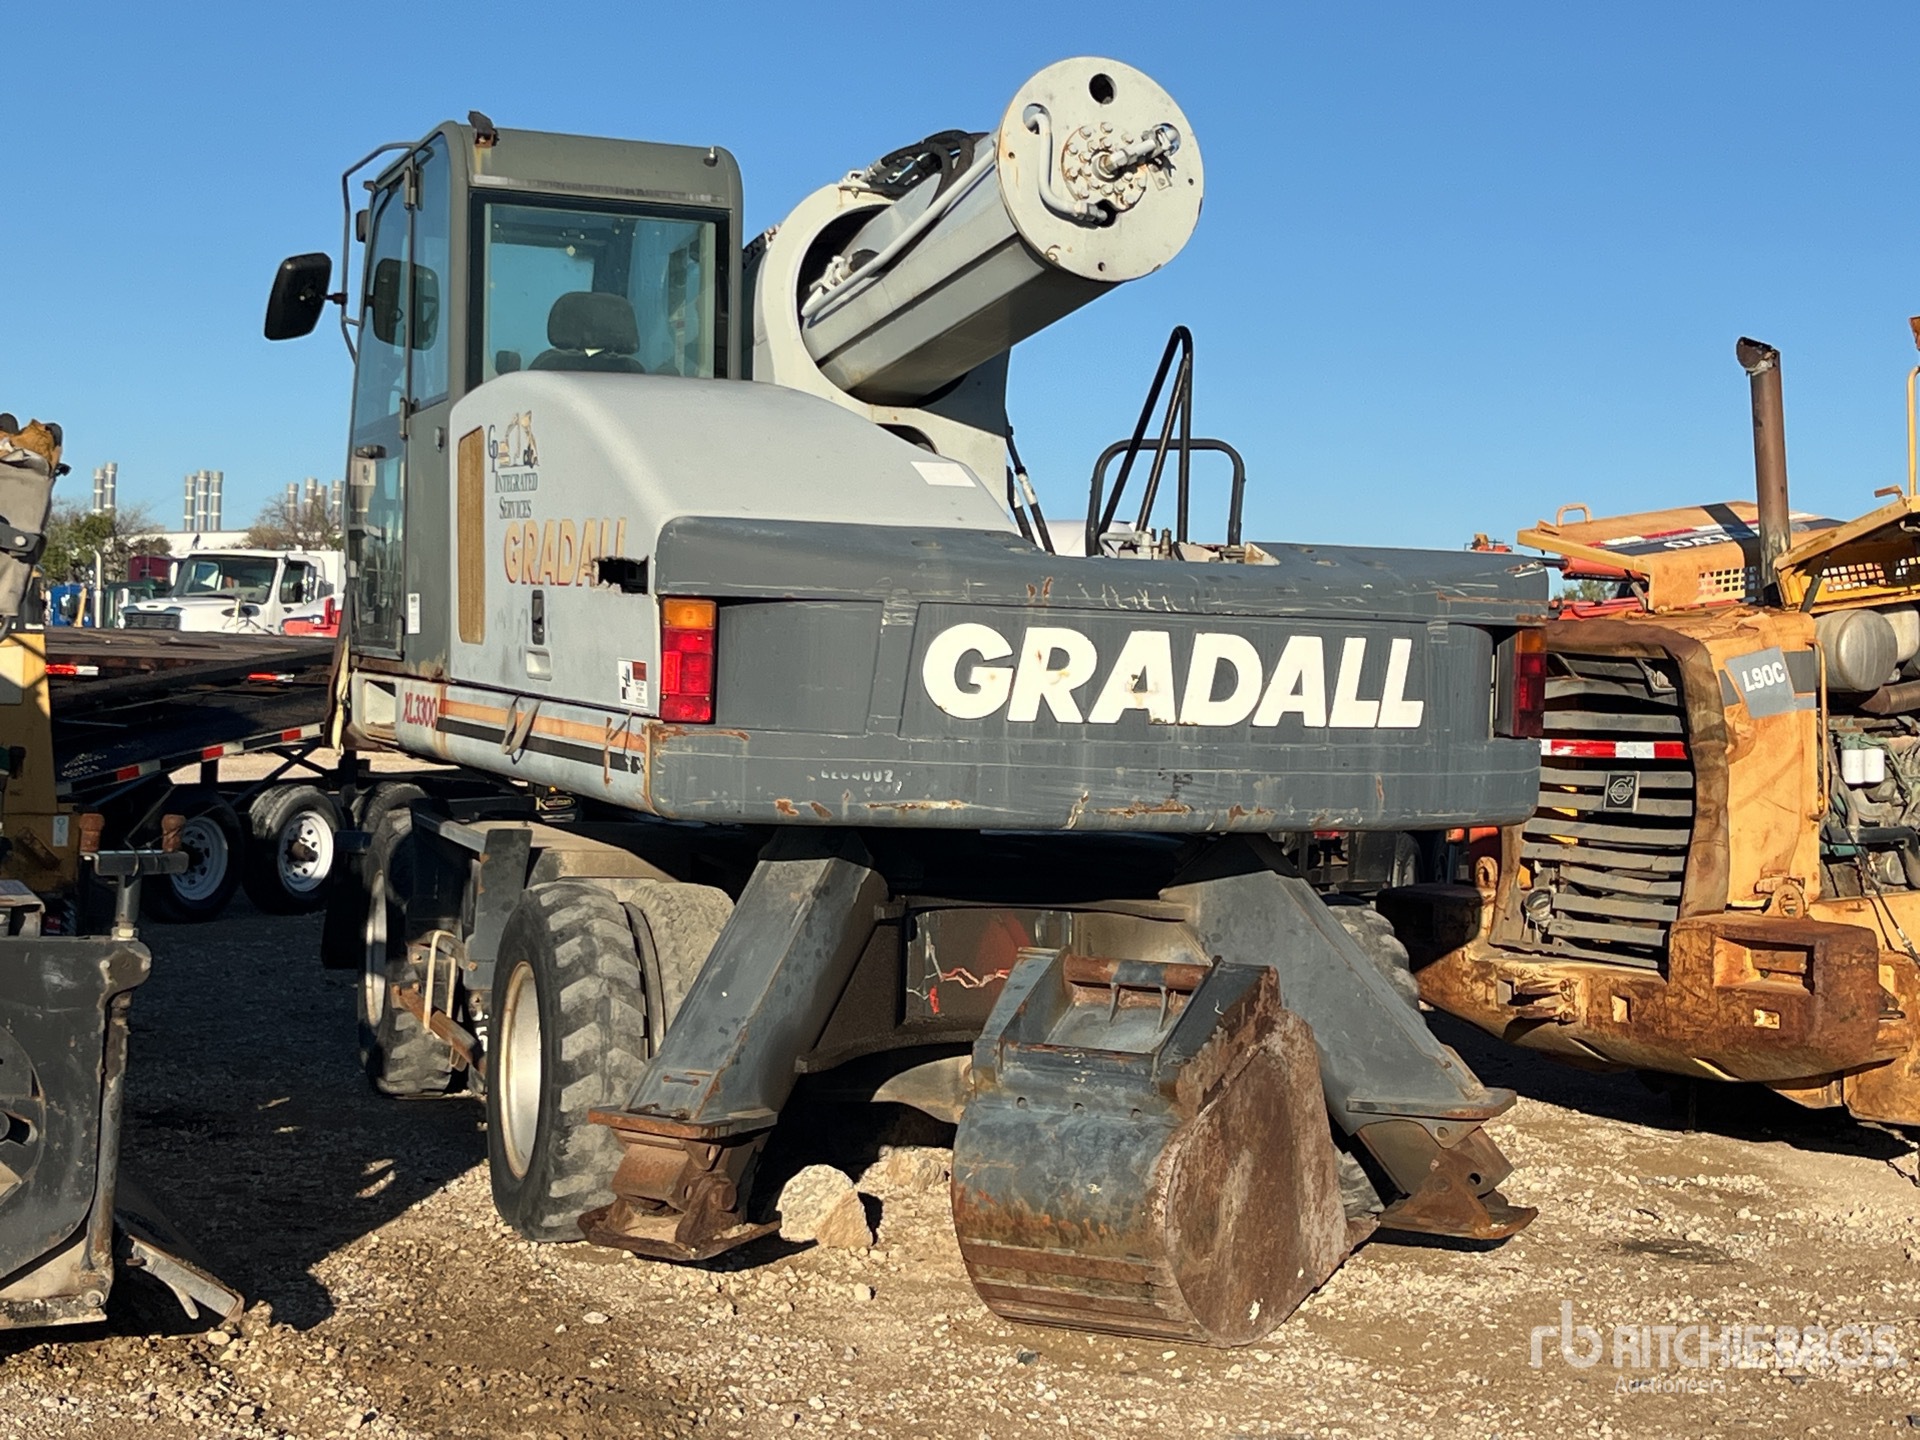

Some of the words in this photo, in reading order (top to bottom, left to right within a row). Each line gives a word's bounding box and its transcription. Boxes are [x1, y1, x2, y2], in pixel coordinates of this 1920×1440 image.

[499, 496, 532, 519] SERVICES
[922, 622, 1425, 729] GRADALL
[1741, 661, 1786, 692] L90C
[402, 691, 438, 728] XL3300
